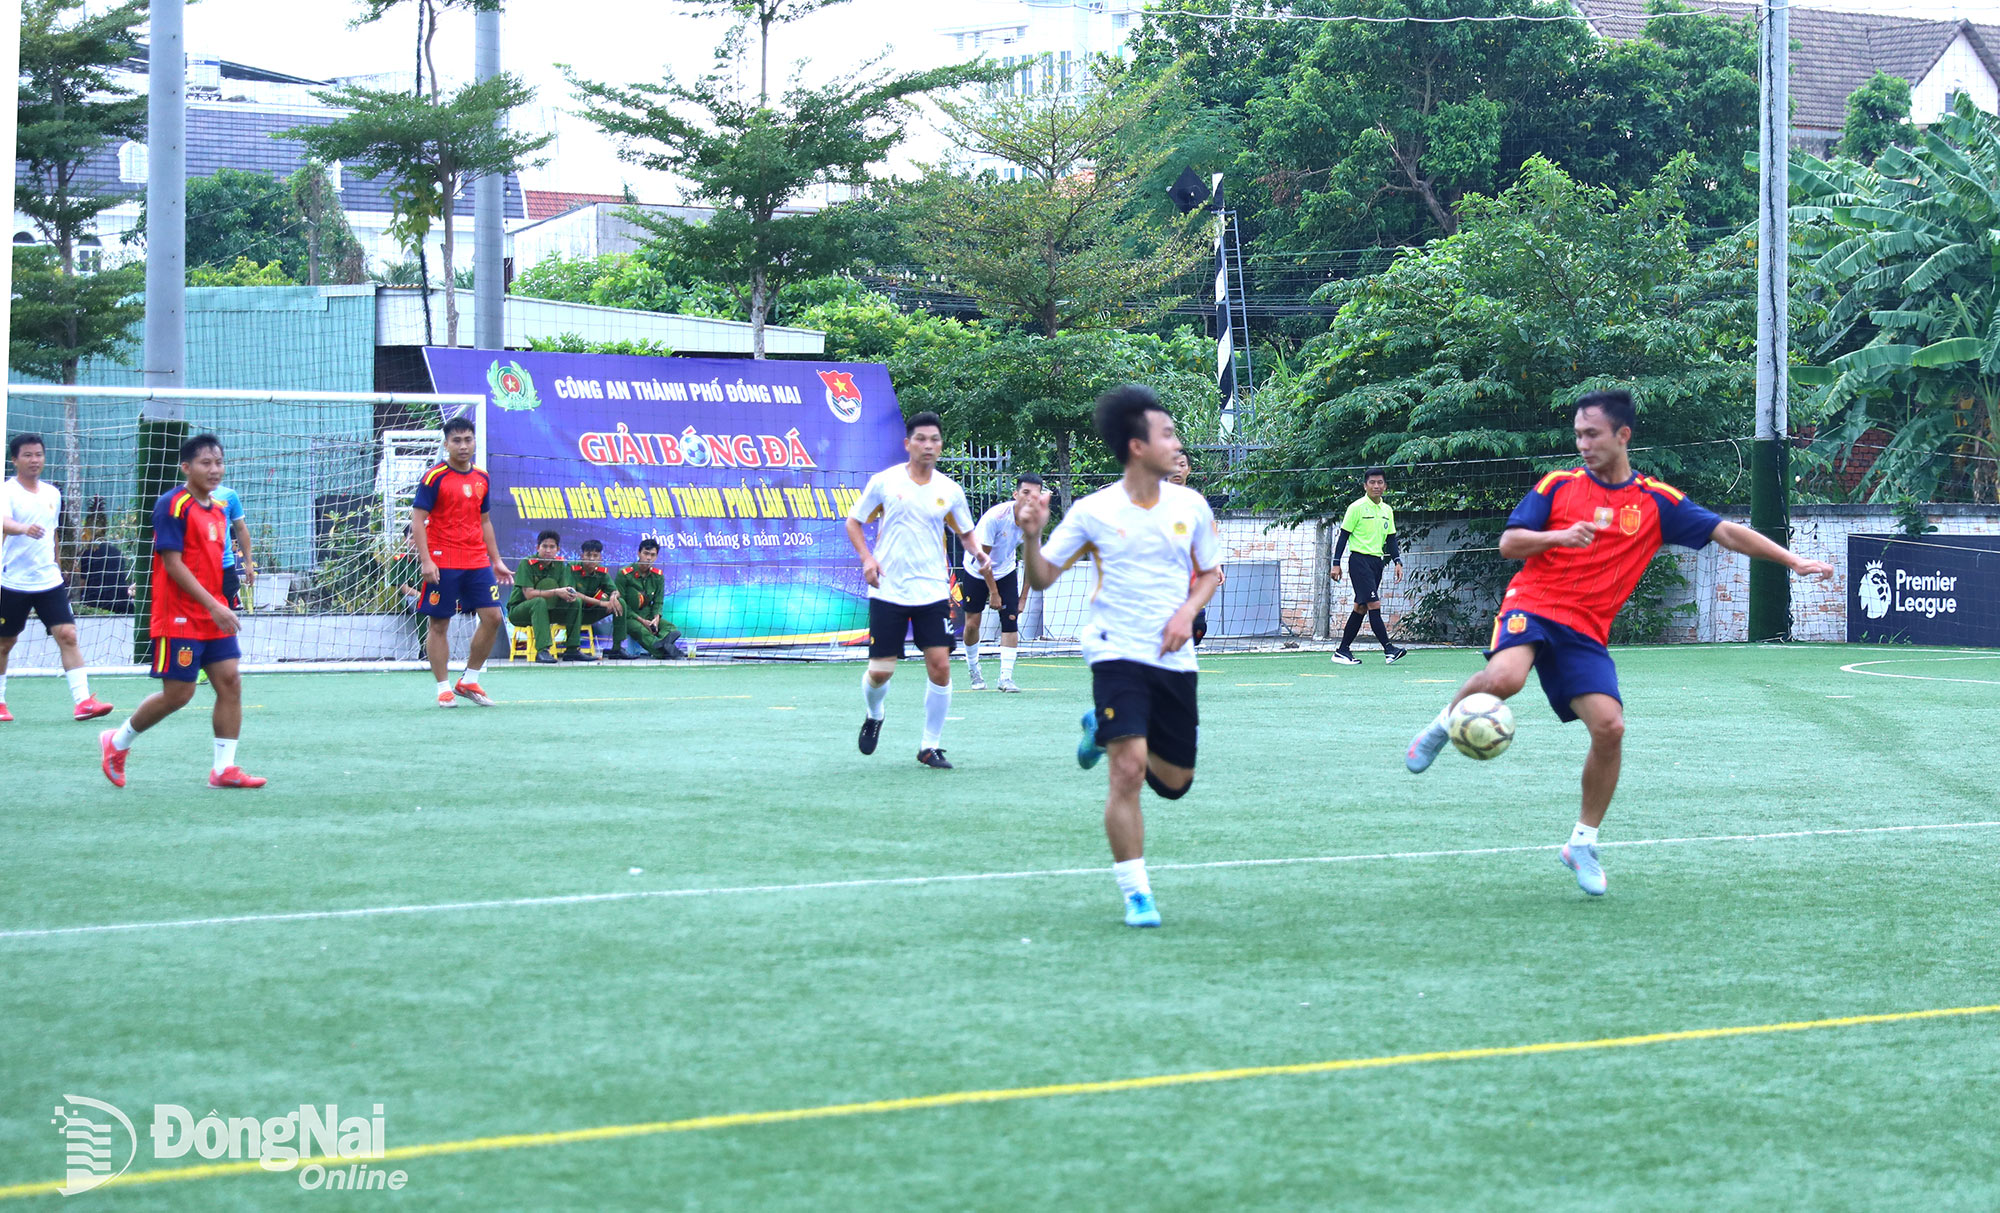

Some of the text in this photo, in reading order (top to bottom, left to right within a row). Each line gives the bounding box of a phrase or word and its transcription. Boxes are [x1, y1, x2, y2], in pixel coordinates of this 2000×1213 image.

[554, 376, 802, 404] CÔNG AN THÀNH PHỐ ĐỒNG NAI
[578, 422, 656, 466] GIẢI
[756, 427, 817, 467] ĐÁ
[509, 486, 568, 519] THANH
[564, 481, 607, 519] NIÊN
[603, 481, 652, 519] CÔNG
[649, 487, 676, 518] AN
[671, 482, 726, 518] THÀNH
[722, 477, 758, 518] PHỐ
[754, 477, 788, 518] LẦN
[677, 531, 702, 548] Nai,
[704, 531, 741, 550] tháng
[742, 533, 751, 546] 8
[782, 532, 813, 546] 2026
[1895, 569, 1957, 591] Premier
[1895, 590, 1957, 619] League
